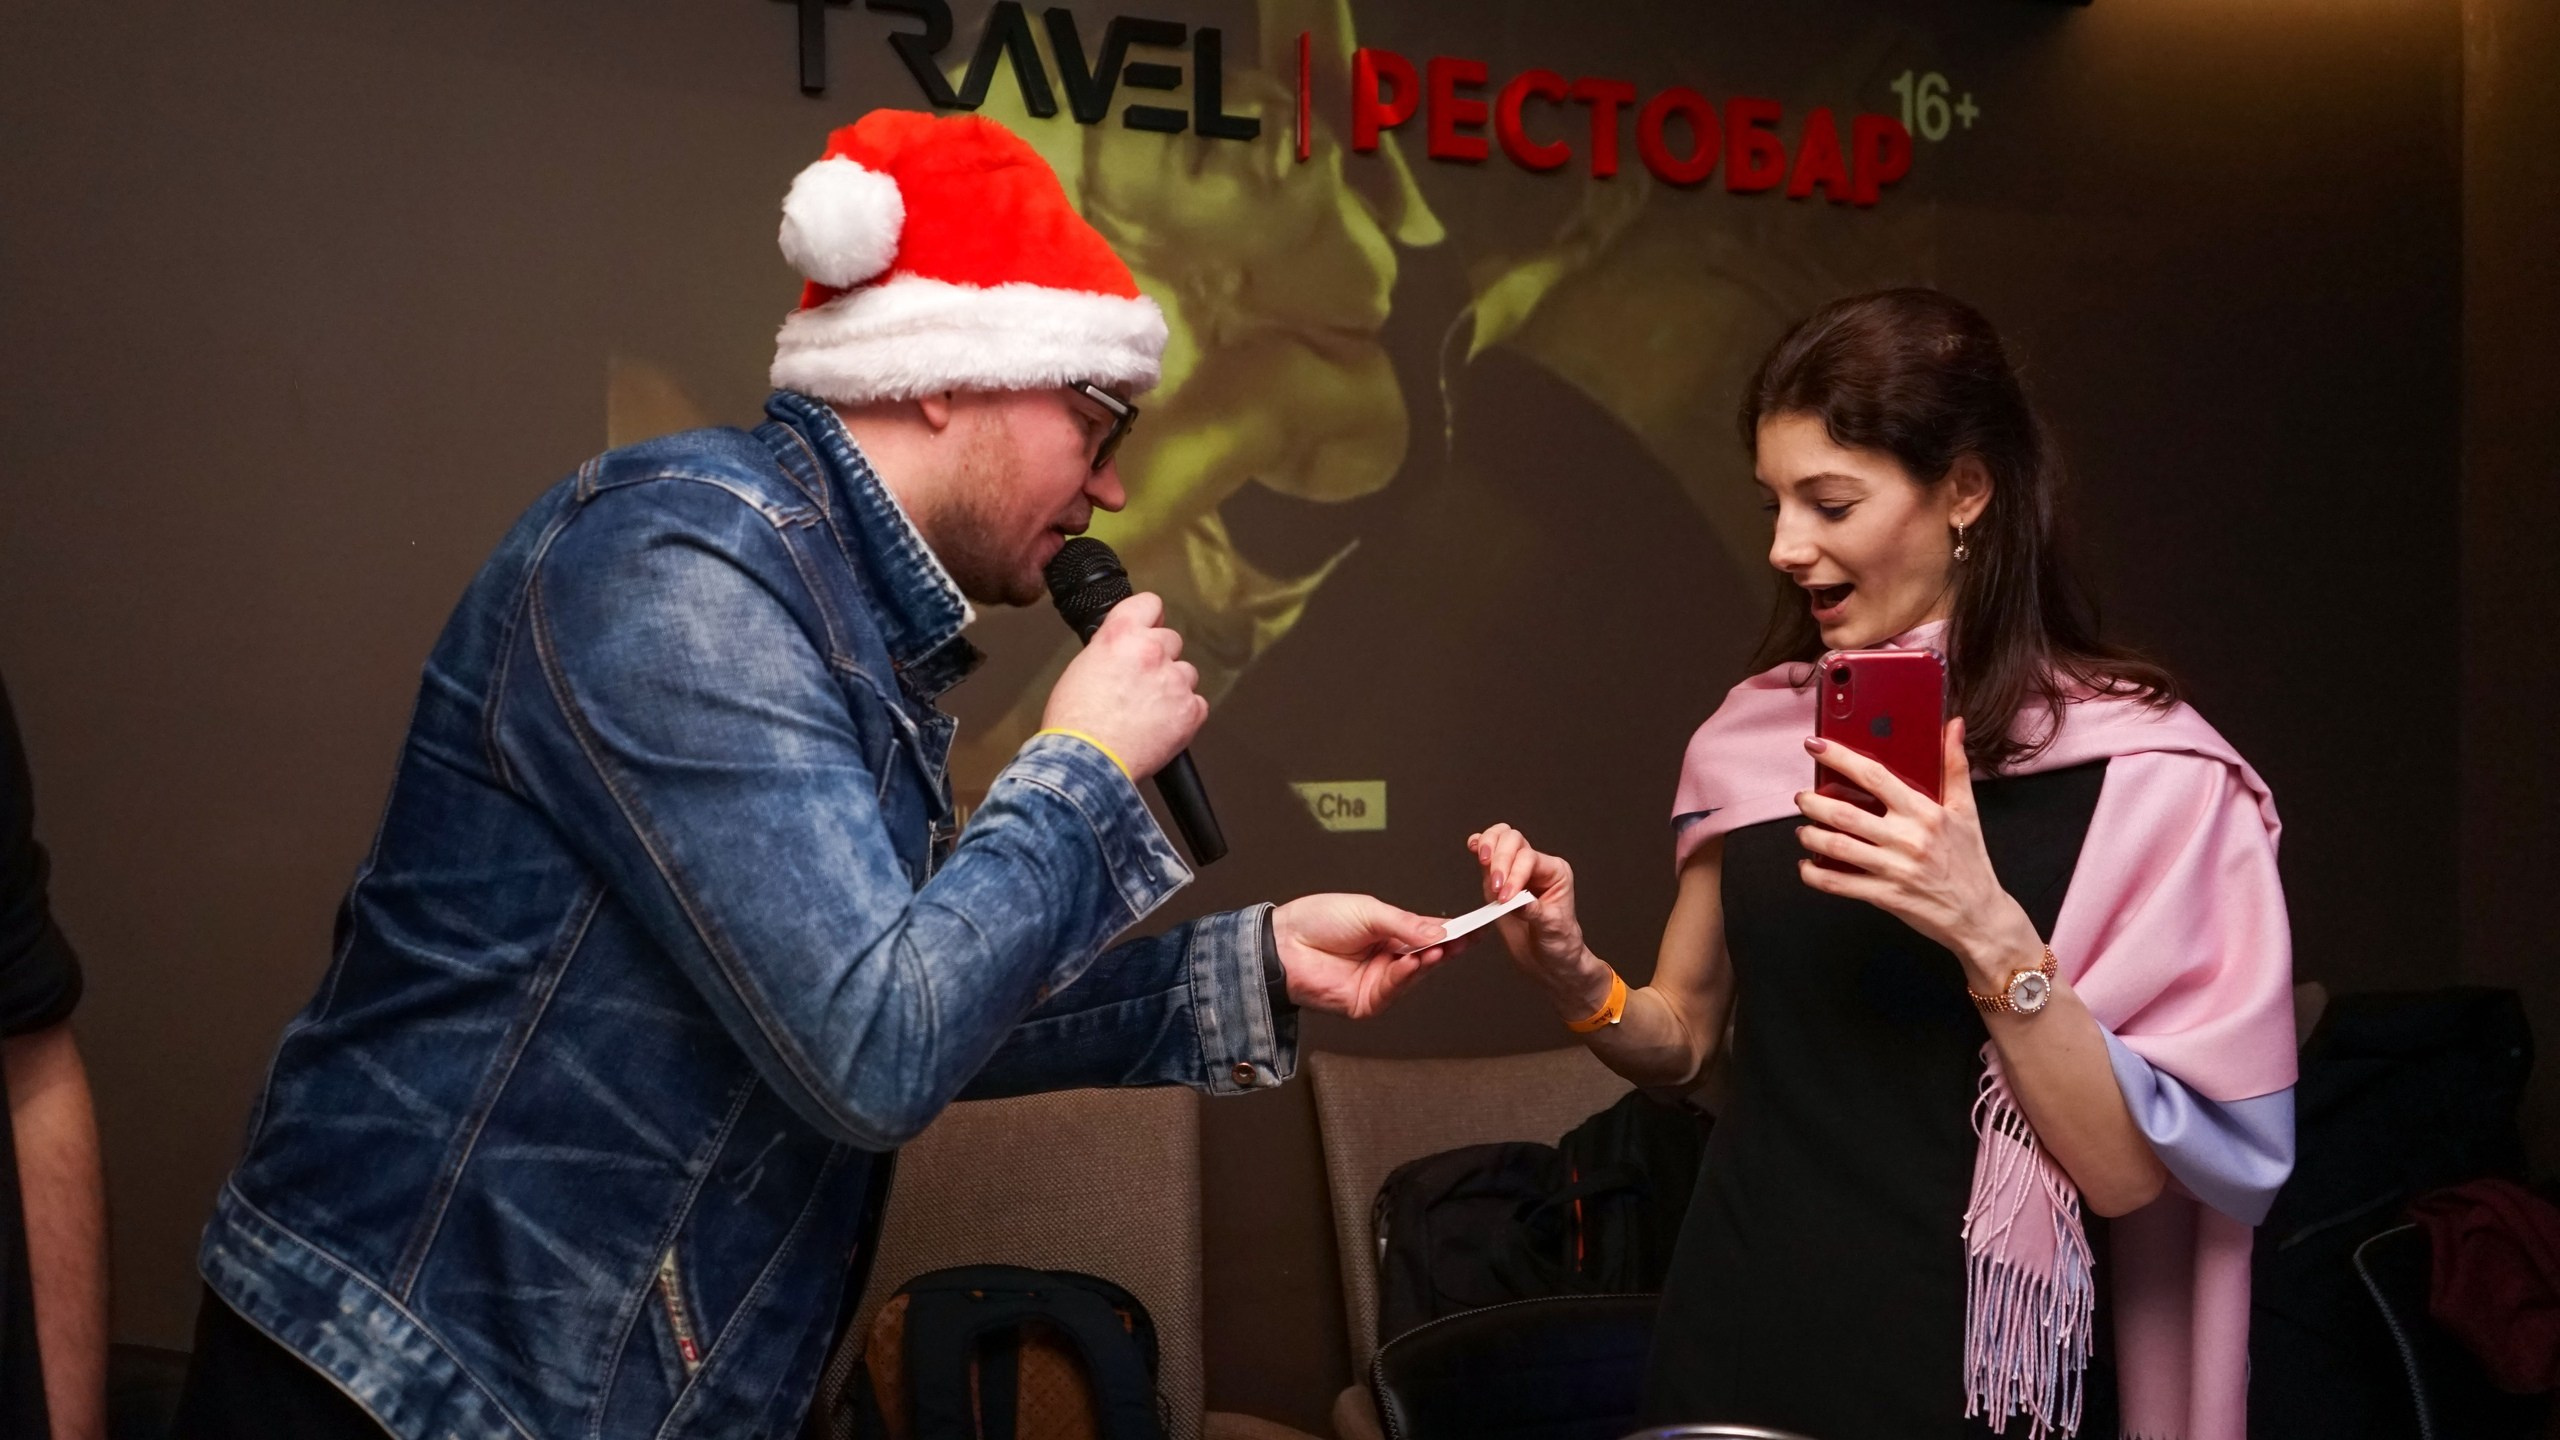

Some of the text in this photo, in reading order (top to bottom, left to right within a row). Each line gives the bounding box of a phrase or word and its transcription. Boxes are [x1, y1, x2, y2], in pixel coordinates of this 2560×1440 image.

[769, 0, 1260, 140] TRAVEL
[1890, 69, 1980, 142] 16+
[1352, 46, 1913, 208] РЕСТОБАР
[1316, 792, 1366, 820] Cha
